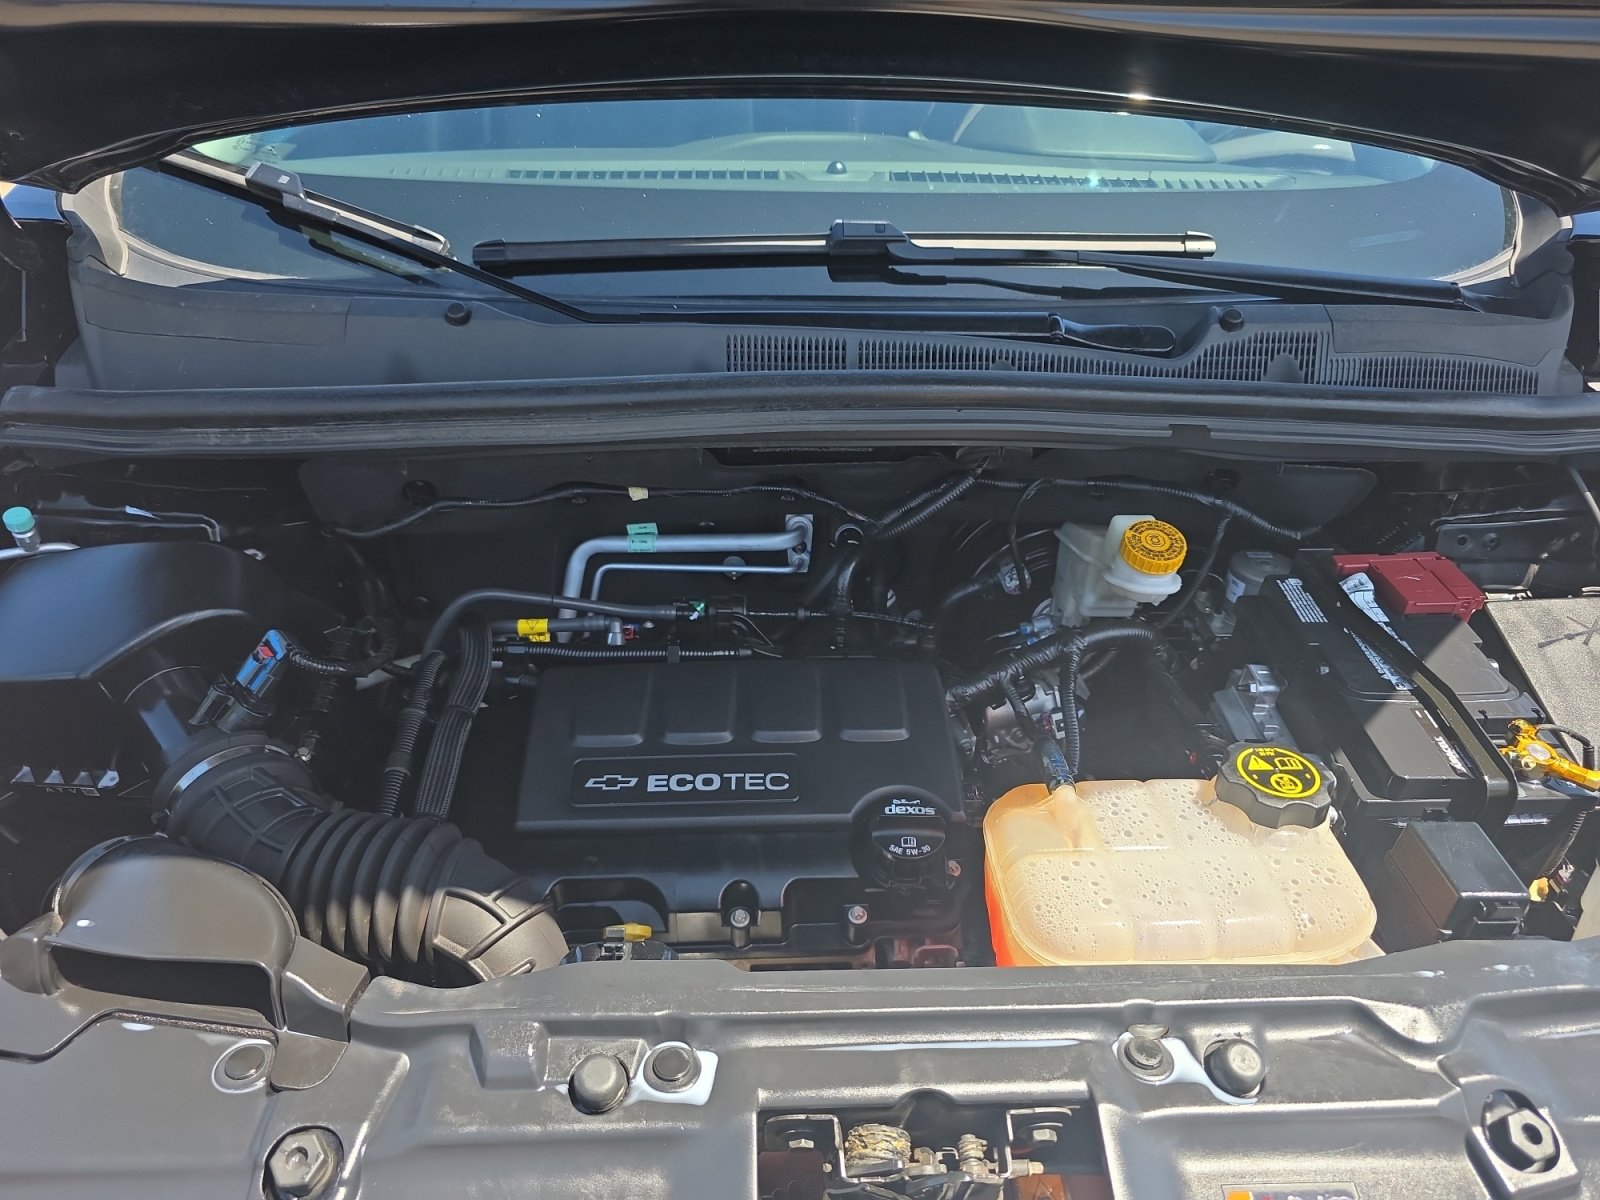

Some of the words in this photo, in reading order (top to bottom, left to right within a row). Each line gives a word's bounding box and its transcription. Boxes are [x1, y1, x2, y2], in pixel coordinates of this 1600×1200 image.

[647, 772, 790, 792] ECOTEC
[884, 803, 937, 815] dexos
[888, 844, 904, 855] SAE
[905, 844, 931, 856] 5W-30
